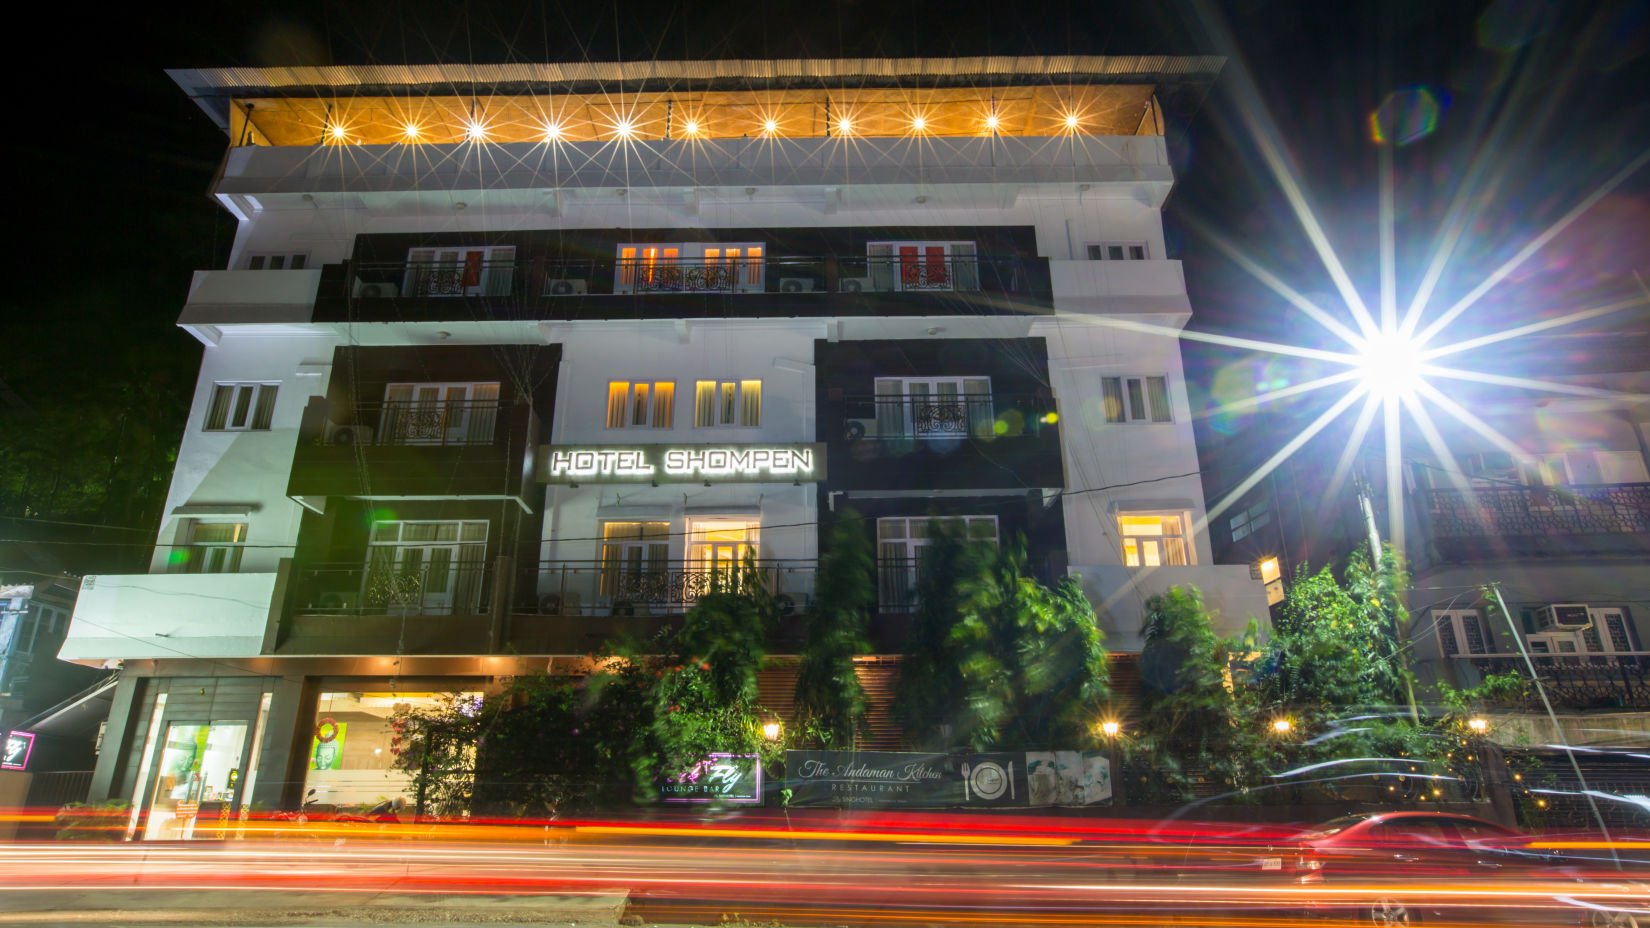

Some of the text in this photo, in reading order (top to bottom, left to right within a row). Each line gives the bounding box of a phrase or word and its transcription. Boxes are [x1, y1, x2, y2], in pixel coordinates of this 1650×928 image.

[552, 449, 814, 475] HOTEL SHOMPEN
[708, 765, 743, 793] Fly
[798, 759, 942, 781] The Andaman Kitchen
[661, 785, 720, 793] LOUNGE BAR
[831, 783, 910, 793] RESTAURANT
